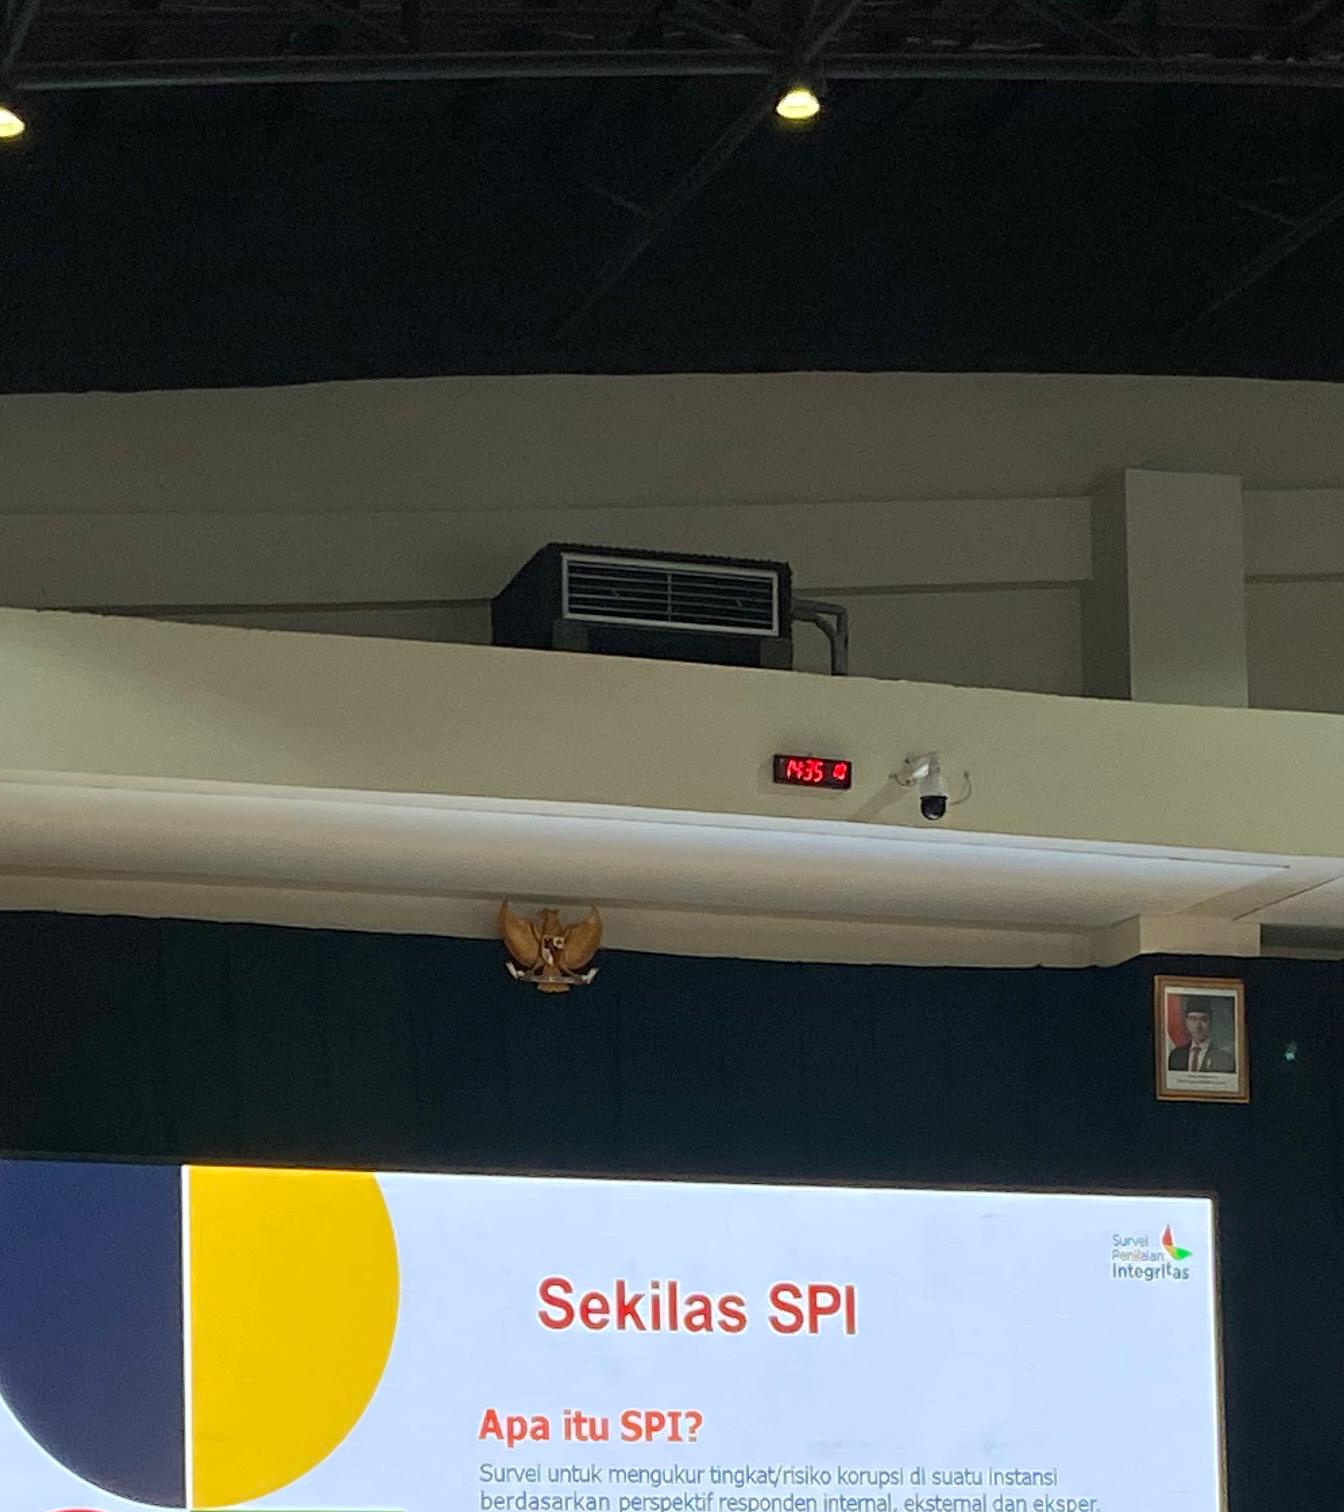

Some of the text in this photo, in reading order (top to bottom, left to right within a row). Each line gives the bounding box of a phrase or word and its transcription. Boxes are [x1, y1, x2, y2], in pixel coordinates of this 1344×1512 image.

[1112, 1262, 1190, 1281] Integritas
[537, 1277, 856, 1335] Sekilas SPI
[478, 1408, 703, 1448] Apa itu SPI?
[479, 1464, 1058, 1489] Survei untuk mengukur tingkat/risiko korupsi di suatu instansi
[480, 1490, 611, 1511] berdasarkan
[904, 1494, 987, 1512] eksternal
[992, 1494, 1028, 1512] dan
